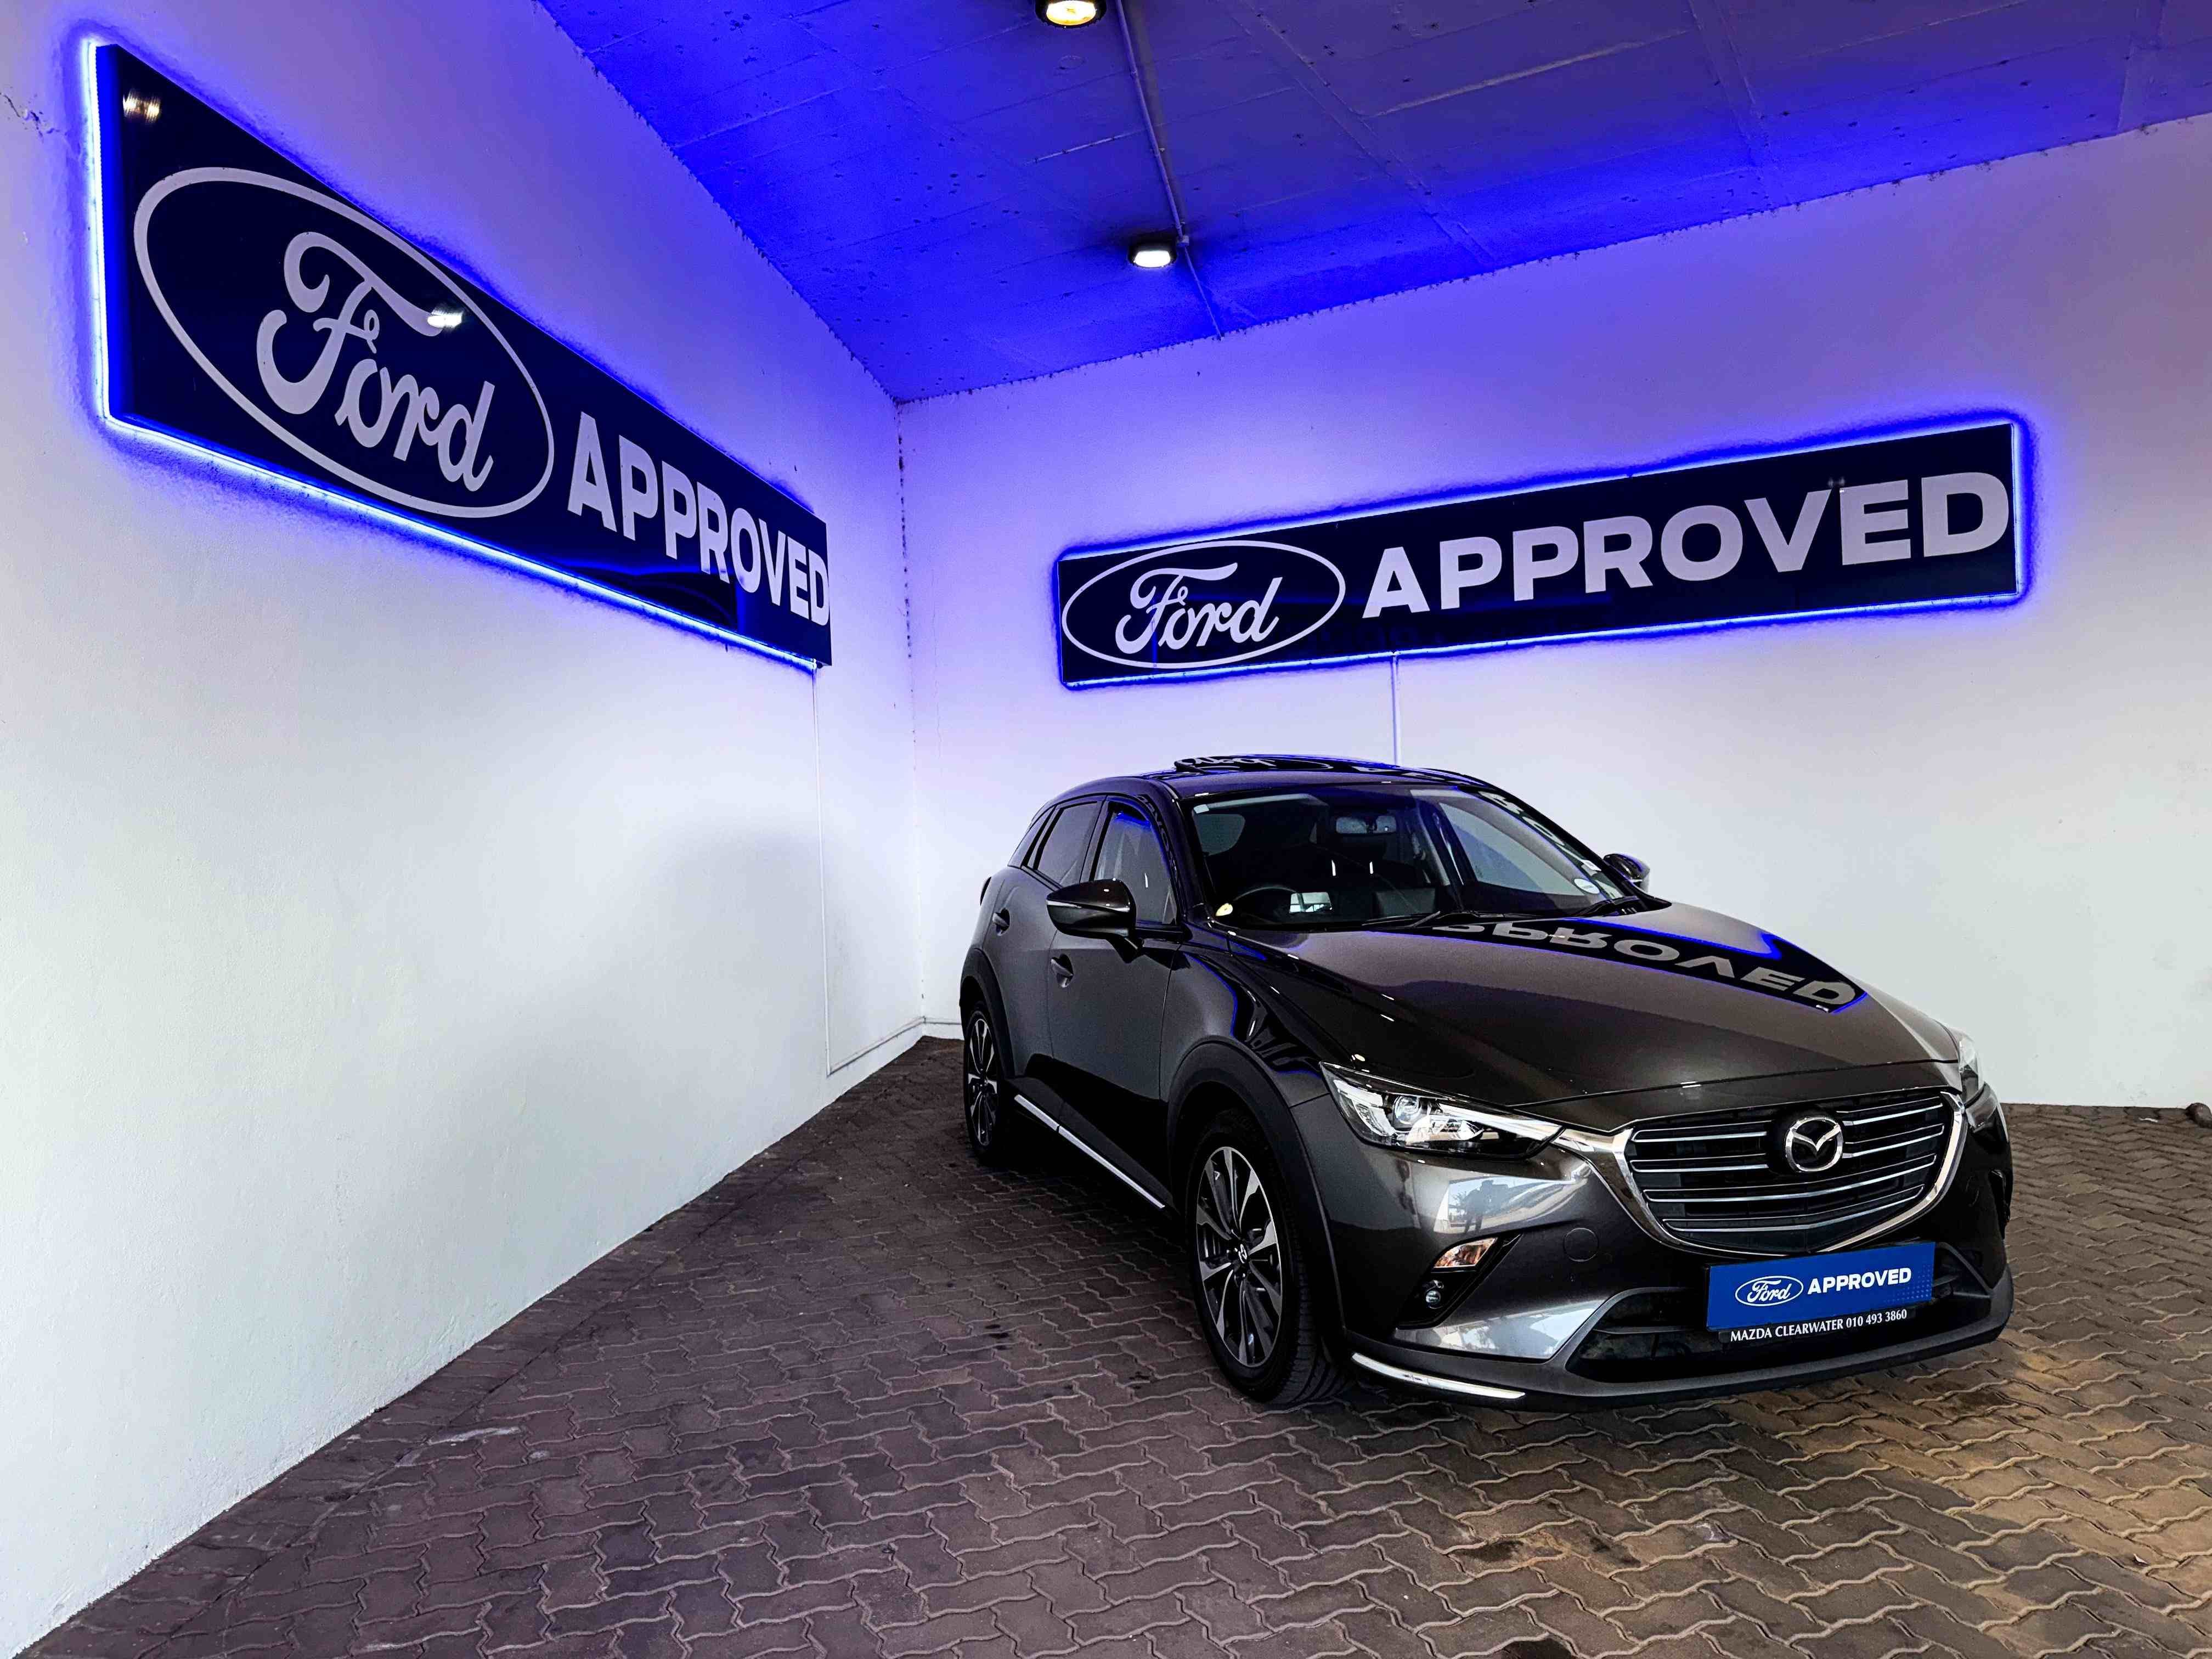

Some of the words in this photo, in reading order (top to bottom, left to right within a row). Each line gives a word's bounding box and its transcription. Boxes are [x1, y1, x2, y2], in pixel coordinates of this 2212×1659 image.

[256, 232, 494, 492] Ford
[567, 411, 830, 626] APPROVED
[1115, 562, 1283, 654] Ford
[1362, 471, 2010, 618] APPROVED
[1730, 1328, 1773, 1342] MAZDA
[1775, 1319, 1843, 1337] CLEARWATER
[1846, 1316, 1864, 1328] 010
[1865, 1313, 1882, 1326] 493
[1884, 1309, 1908, 1323] 3860
[1747, 1279, 1791, 1303] Ford
[1807, 1267, 1911, 1295] APPROVED
